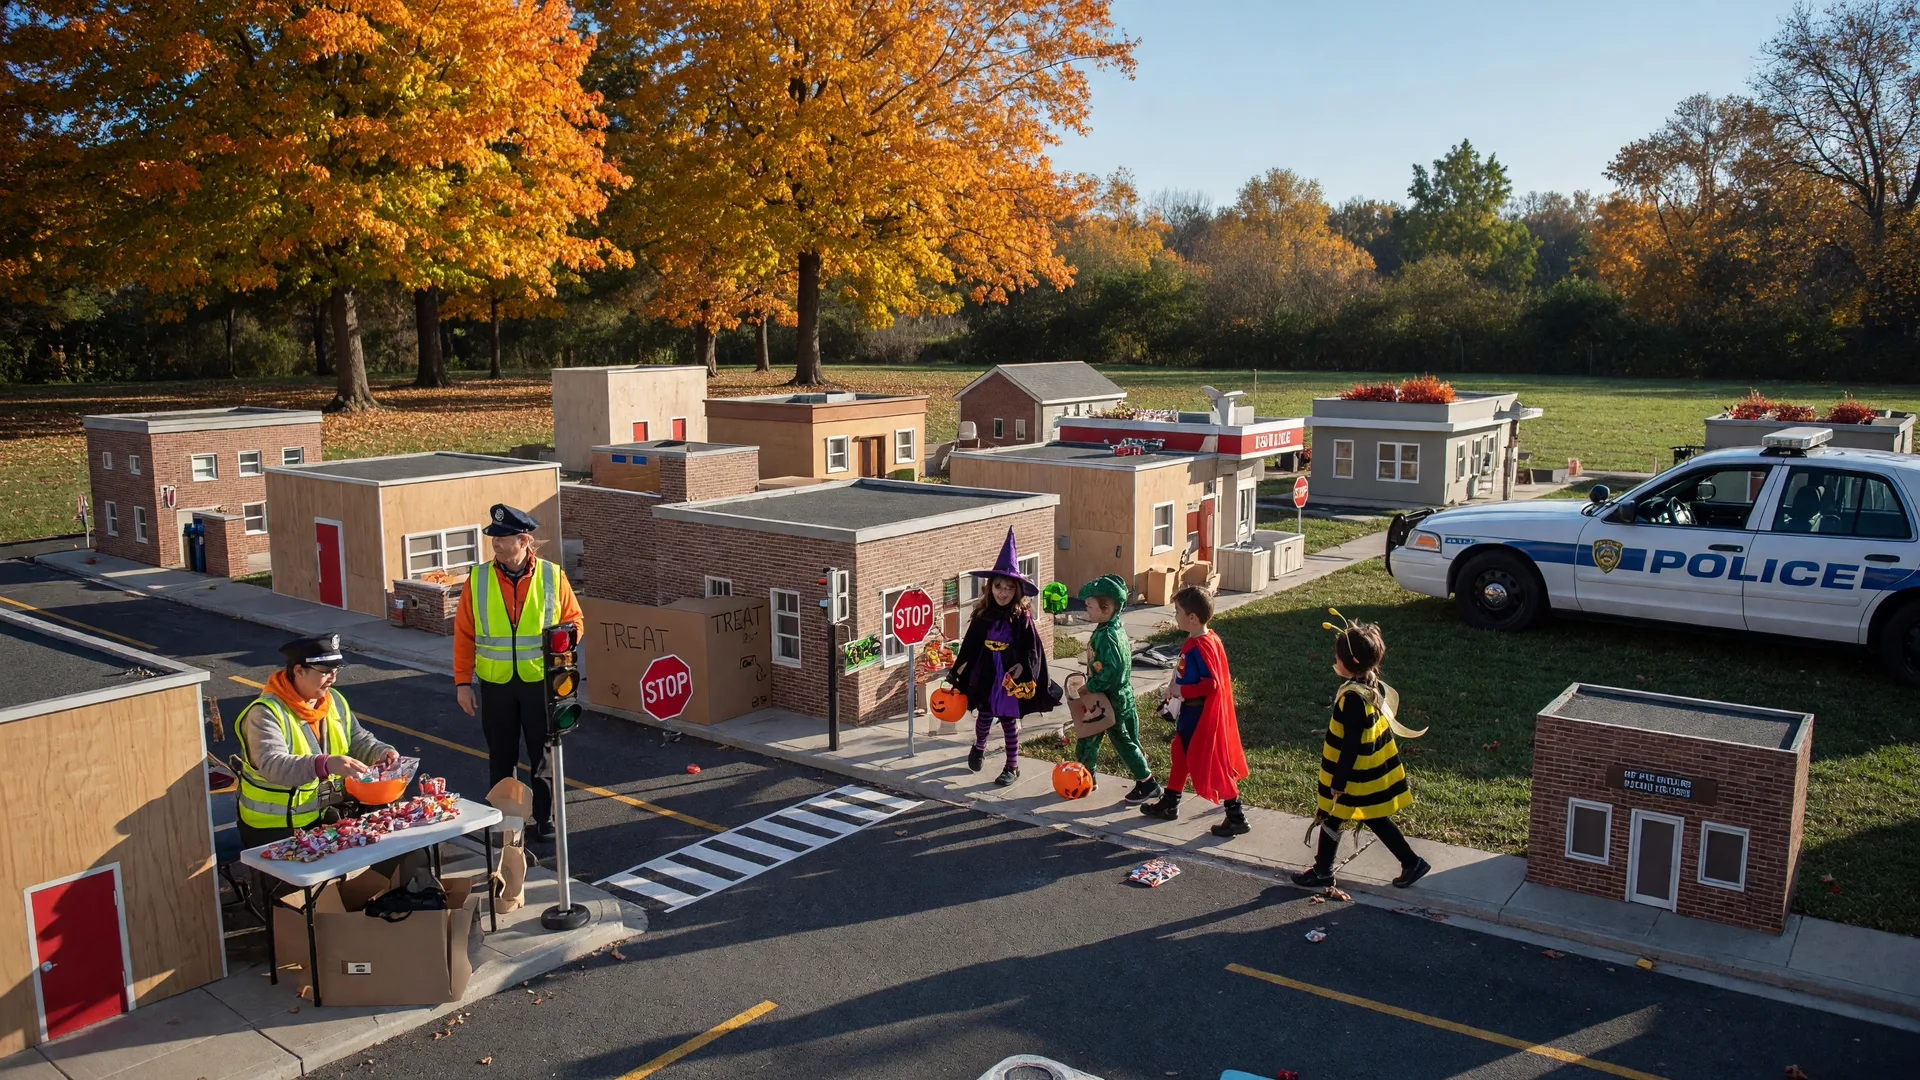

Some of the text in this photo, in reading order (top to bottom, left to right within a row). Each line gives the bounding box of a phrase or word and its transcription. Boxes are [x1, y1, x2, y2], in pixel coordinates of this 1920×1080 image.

[1650, 549, 1860, 590] POLICE
[711, 605, 764, 634] TREAT
[895, 604, 931, 630] STOP
[600, 622, 669, 652] TREAT
[645, 671, 688, 704] STOP
